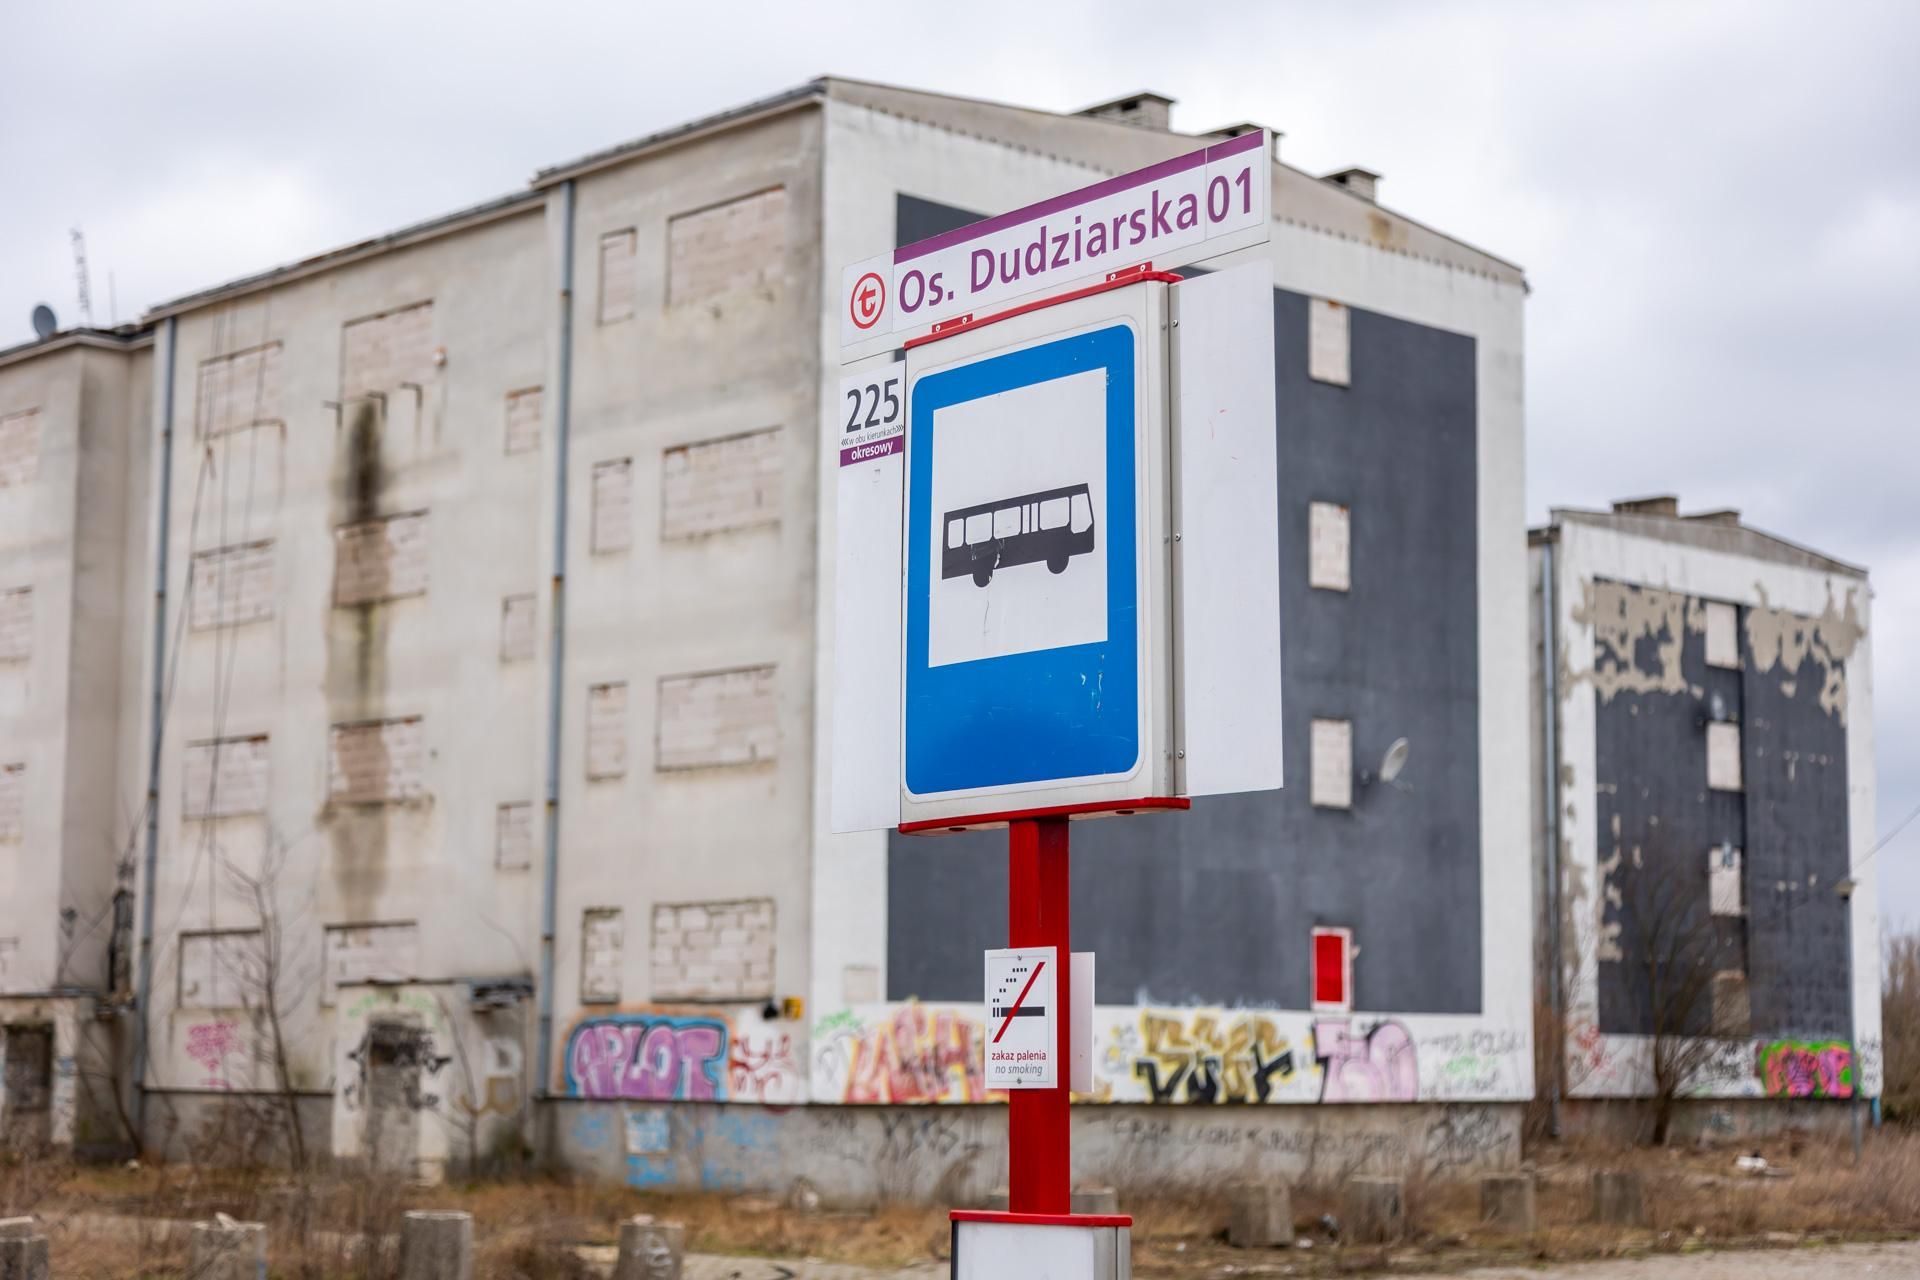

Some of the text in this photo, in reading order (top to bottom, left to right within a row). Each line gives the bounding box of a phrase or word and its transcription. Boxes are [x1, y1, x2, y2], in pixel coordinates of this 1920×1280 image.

[899, 166, 1252, 313] Os. Dudziarska 01
[845, 378, 900, 433] 225
[867, 427, 897, 440] kierunkach
[851, 441, 893, 460] okresowy
[991, 1050, 1046, 1062] zakaz palenia
[995, 1064, 1043, 1076] no smoking
